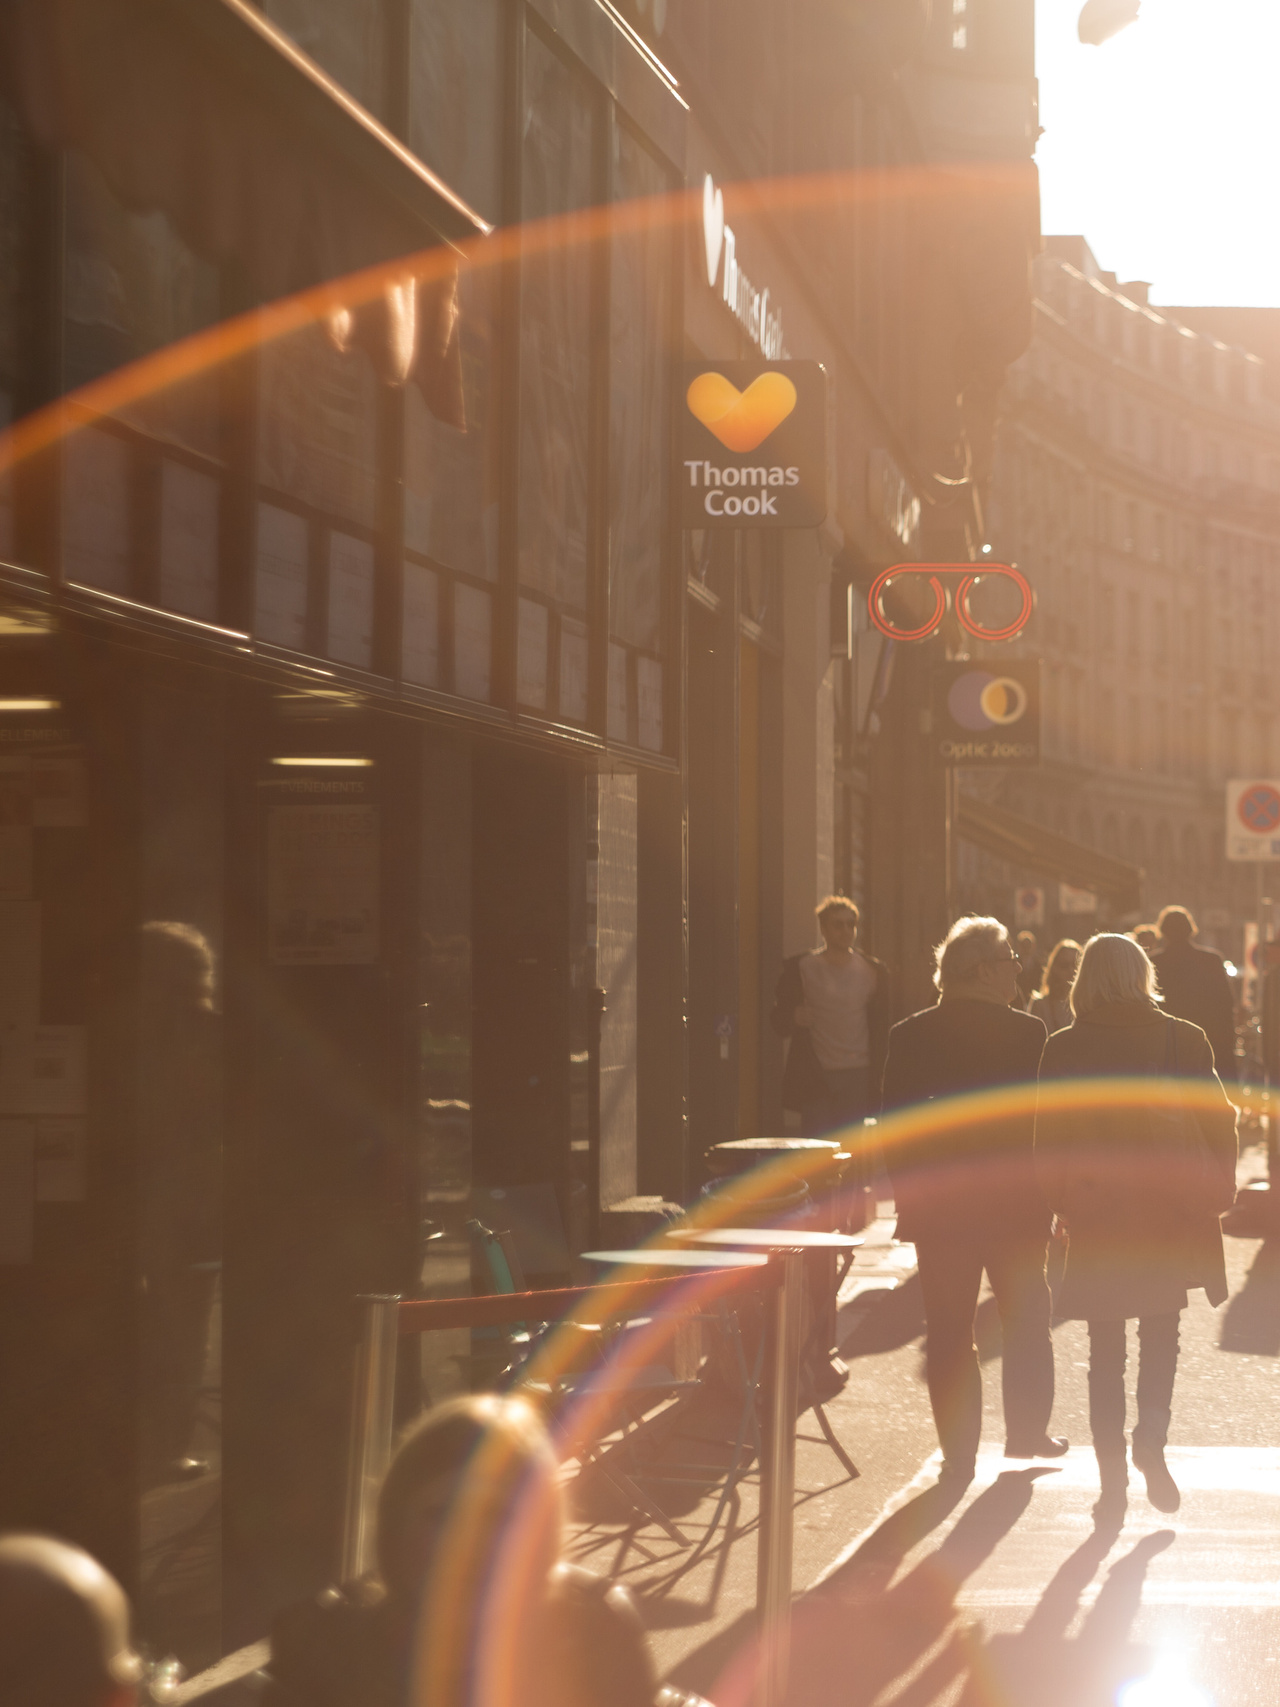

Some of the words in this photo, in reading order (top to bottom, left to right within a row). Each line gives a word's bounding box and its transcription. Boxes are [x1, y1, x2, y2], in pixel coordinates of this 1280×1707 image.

[684, 460, 800, 486] Thomas
[704, 489, 778, 516] Cook
[939, 739, 988, 762] Optic
